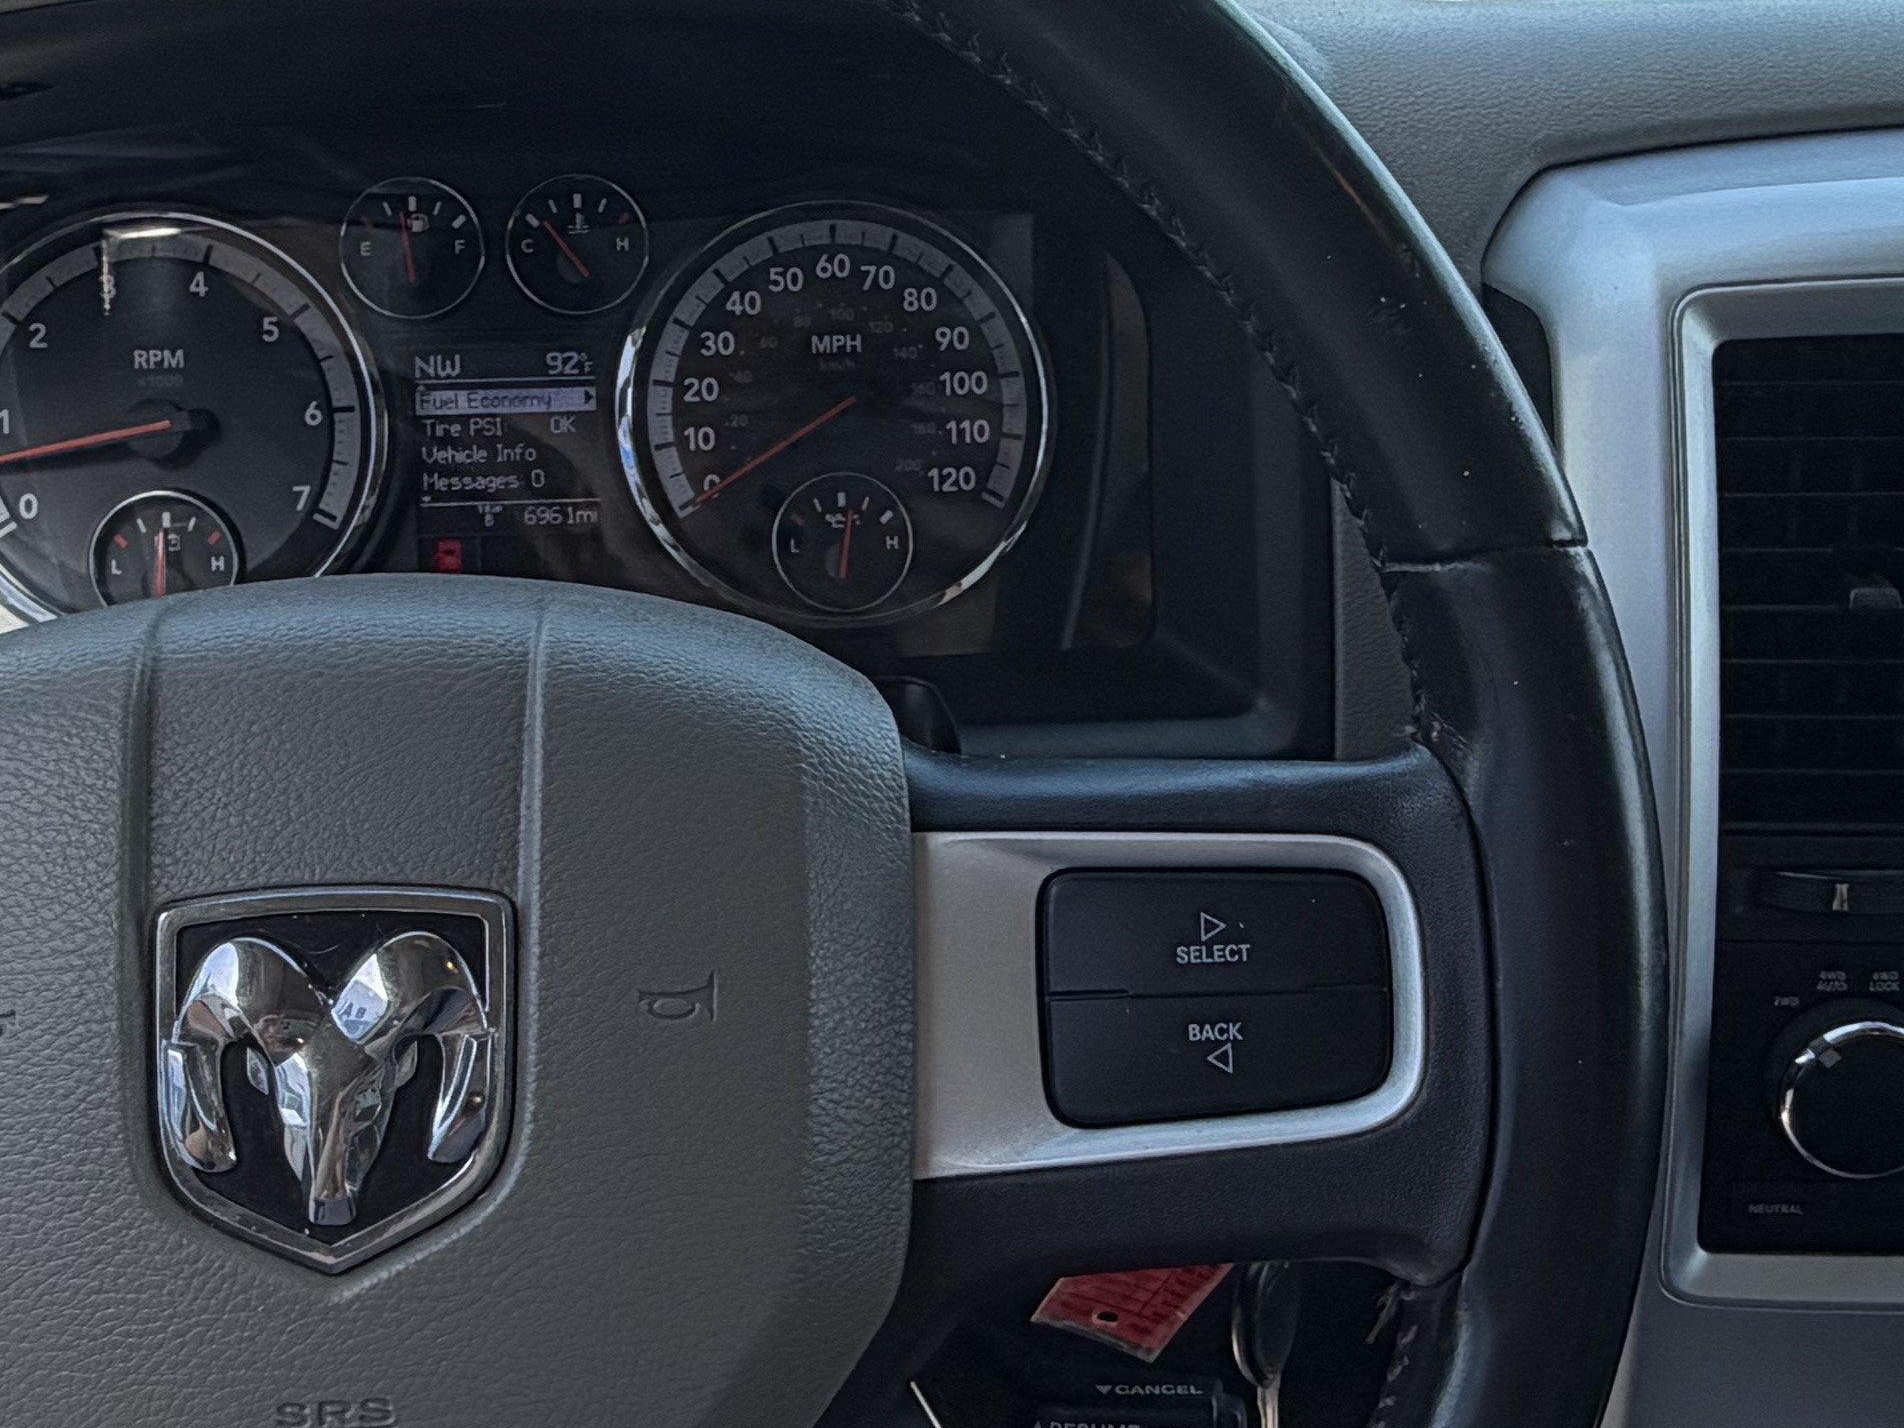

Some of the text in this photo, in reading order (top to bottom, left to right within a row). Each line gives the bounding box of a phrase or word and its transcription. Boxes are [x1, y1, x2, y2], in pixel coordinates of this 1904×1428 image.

[454, 239, 466, 254] F
[521, 237, 629, 253] C H
[815, 253, 851, 278] 60
[860, 264, 895, 290] 70
[189, 271, 208, 297] 4
[768, 267, 804, 292] 50
[725, 291, 762, 315] 40
[903, 287, 937, 312] 80
[29, 323, 48, 349] 2
[262, 317, 280, 343] 5
[934, 326, 970, 352] 90
[700, 331, 735, 356] 30
[811, 333, 863, 354] MPH
[133, 349, 185, 369] RPM
[415, 354, 461, 378] NW
[683, 377, 718, 402] 20
[939, 370, 988, 396] 100
[420, 391, 552, 410] Fuel Economy
[304, 401, 323, 426] 6
[421, 415, 576, 437] Tire PSI OK
[684, 426, 716, 451] 10
[946, 419, 991, 444] 110
[421, 443, 537, 464] Vehicle Info
[422, 471, 520, 493] Messages
[927, 466, 976, 492] 120
[19, 493, 38, 519] 0
[293, 485, 311, 511] 7
[886, 535, 899, 550] H
[1176, 943, 1250, 964] SELECT
[1869, 981, 1900, 992] LOCK
[1188, 1022, 1243, 1041] BACK
[1748, 1202, 1804, 1215] NEUTRAL
[1114, 1384, 1204, 1396] CANCEL
